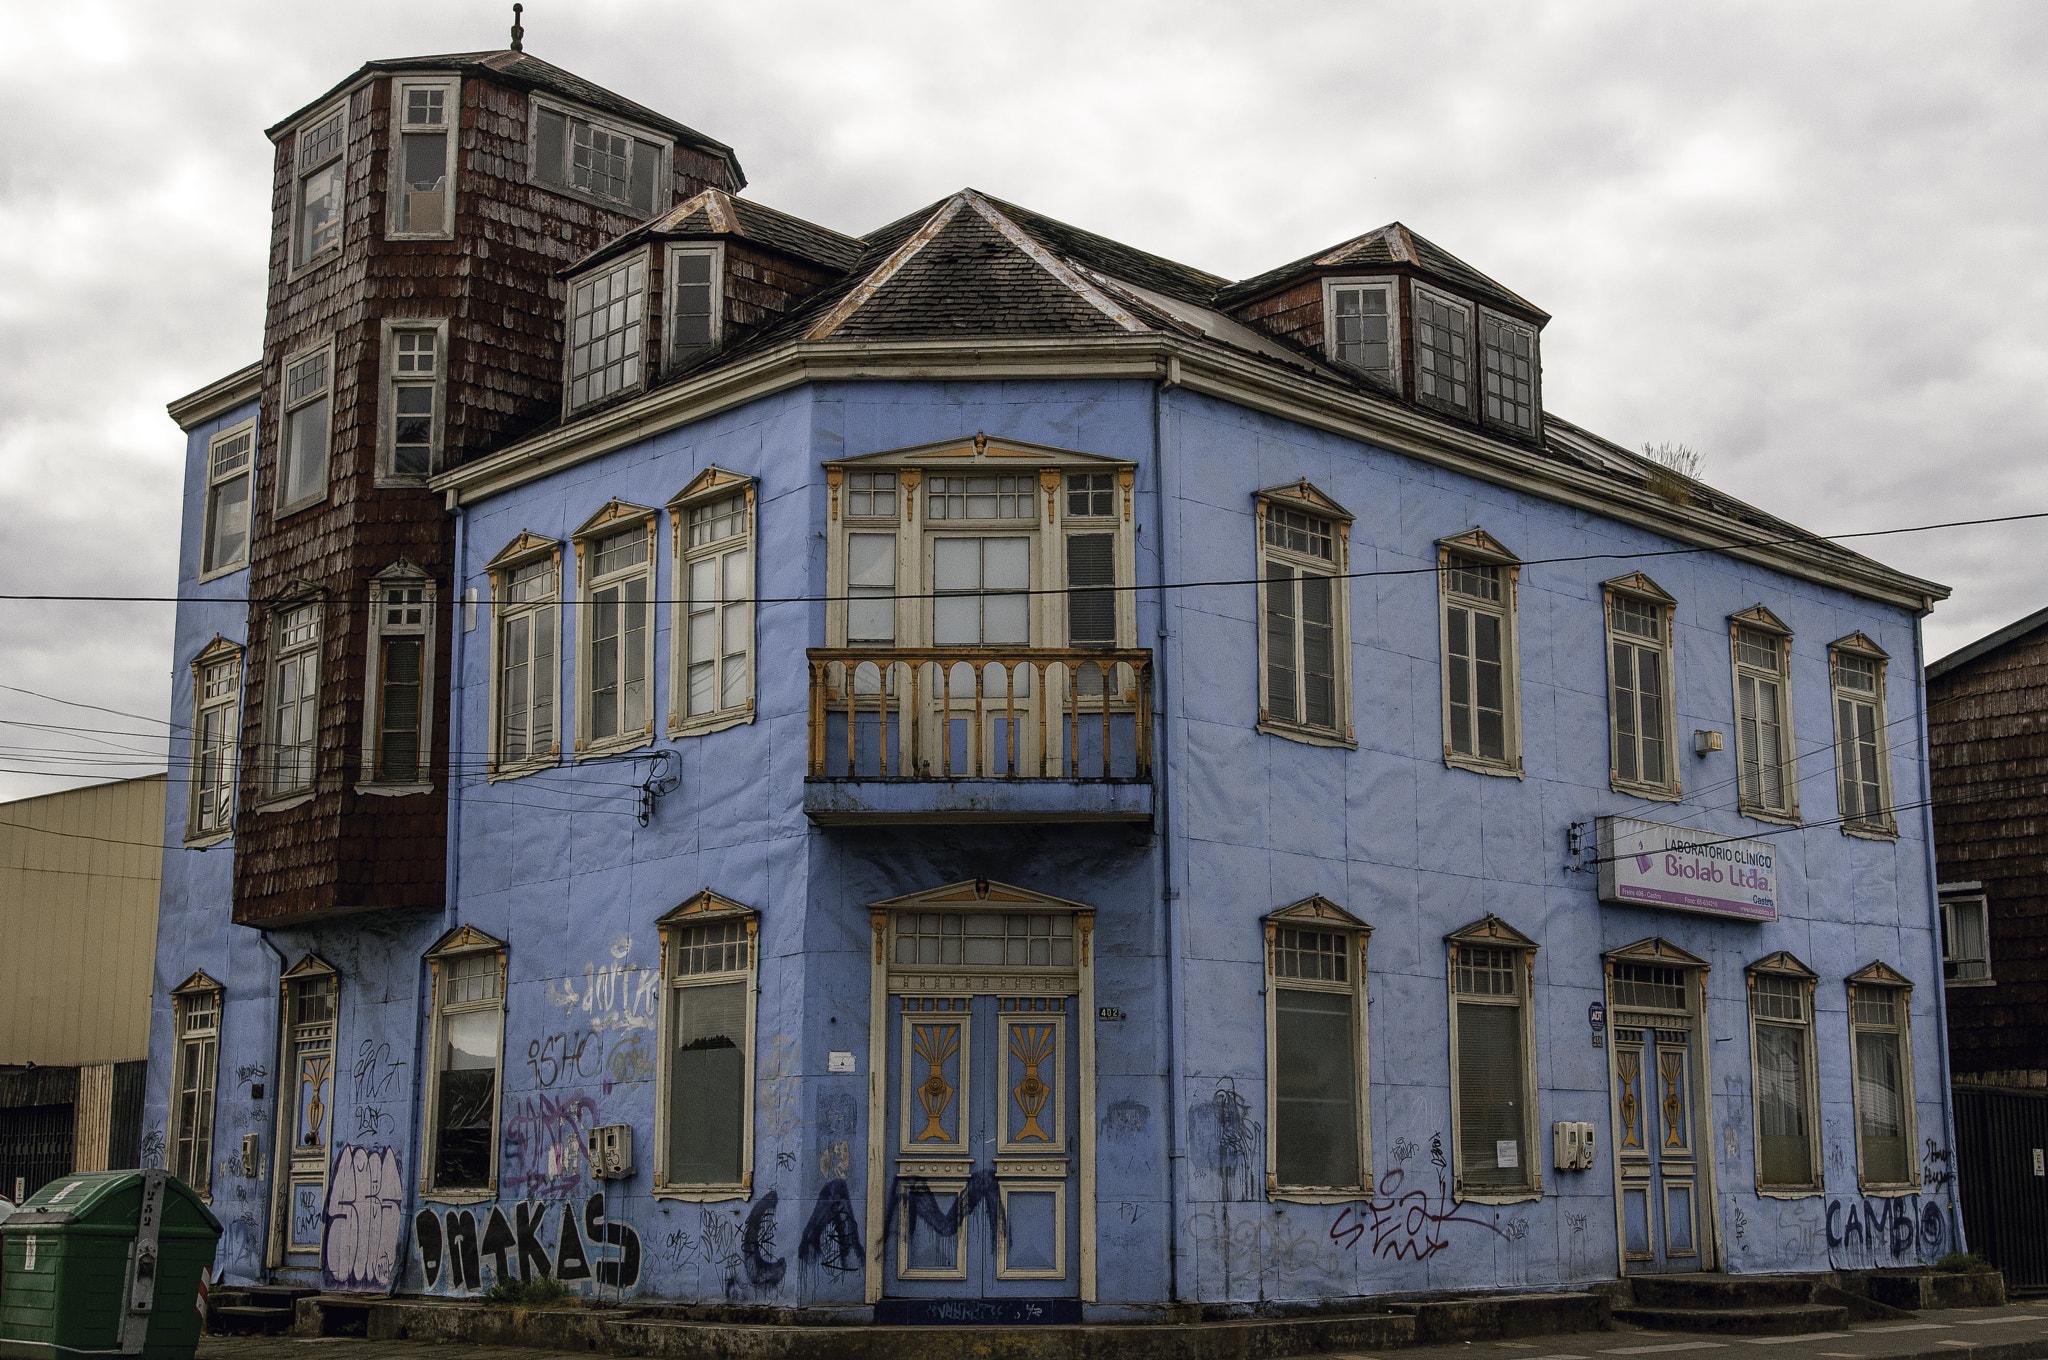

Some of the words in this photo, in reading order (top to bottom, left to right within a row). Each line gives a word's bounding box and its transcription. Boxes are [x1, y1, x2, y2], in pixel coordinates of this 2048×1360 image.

[1665, 838, 1732, 862] LABORATORIO
[1665, 854, 1723, 883] Biolab
[1730, 865, 1773, 892] Ltda.
[1753, 894, 1774, 907] Castro
[1100, 1008, 1118, 1017] 402
[1826, 1195, 1947, 1257] CAMBIO
